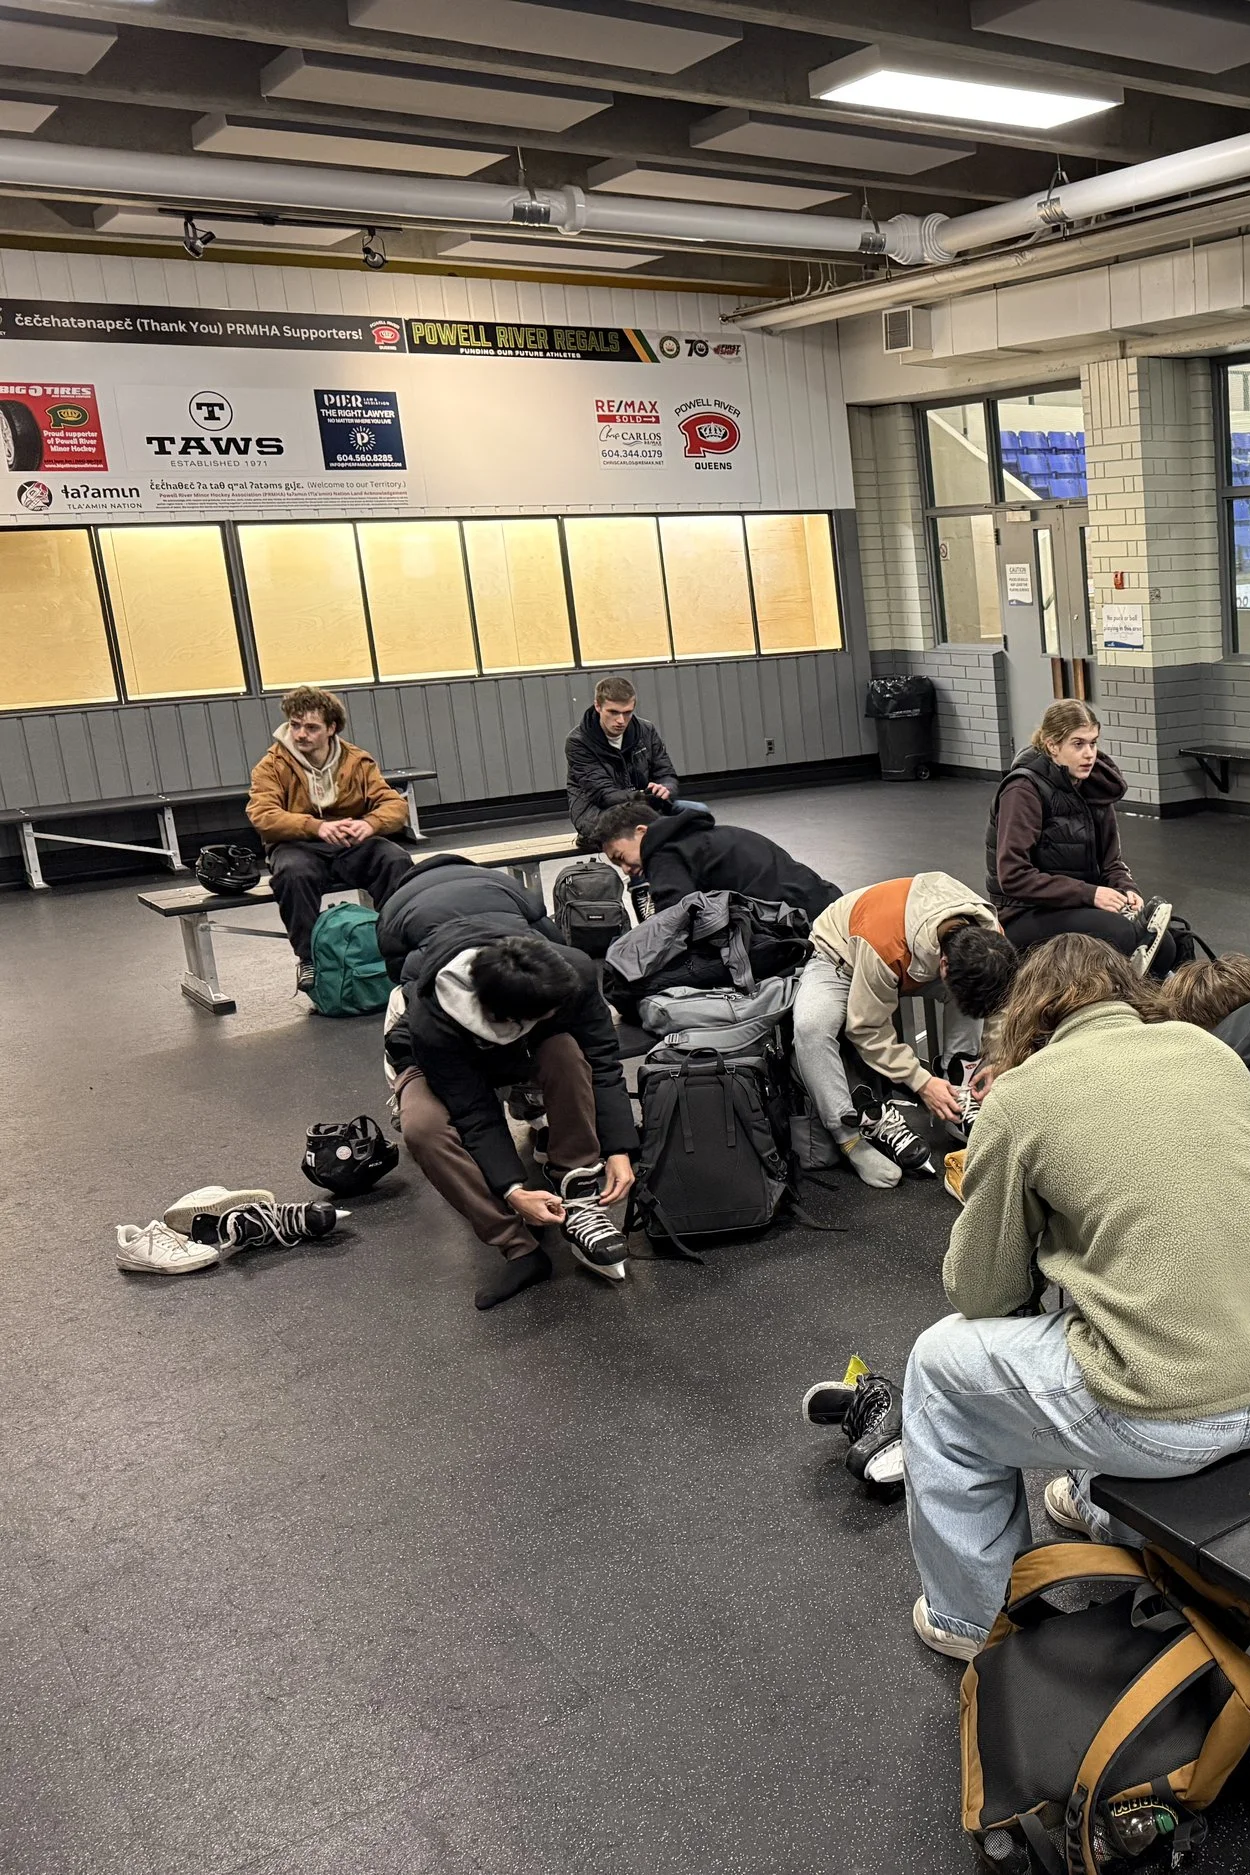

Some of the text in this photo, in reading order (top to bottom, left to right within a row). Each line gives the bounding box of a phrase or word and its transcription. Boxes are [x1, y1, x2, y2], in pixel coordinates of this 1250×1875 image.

[136, 317, 187, 333] (Thank
[189, 321, 223, 336] You)
[226, 323, 281, 337] PRMHA
[283, 325, 363, 341] Supporters!
[411, 321, 620, 353] POWELL RIVER REGALS
[460, 347, 582, 359] FUNDING OUR FUTURE ATHLETES
[43, 386, 92, 396] TIRES
[323, 393, 363, 408] PIER
[595, 399, 659, 414] RE/MAX
[674, 398, 741, 418] POWELL RIVER
[320, 409, 395, 418] THE RIGHT LAWYER
[615, 415, 642, 423] SOLD
[43, 430, 98, 439] Proud supporter
[621, 432, 662, 441] CARLOS
[46, 437, 97, 445] of Powell River
[49, 445, 97, 454] Minor Hockey
[146, 436, 285, 456] TAWS
[336, 453, 394, 462] 604.560.8285
[601, 449, 663, 458] 604.344.0179
[170, 460, 269, 468] ESTABLISHED 1971
[694, 462, 733, 470] QUEENS
[307, 480, 345, 490] (Welcome
[346, 481, 355, 489] to
[370, 480, 407, 490] Territory.)
[67, 502, 108, 510] TLA'AMIN
